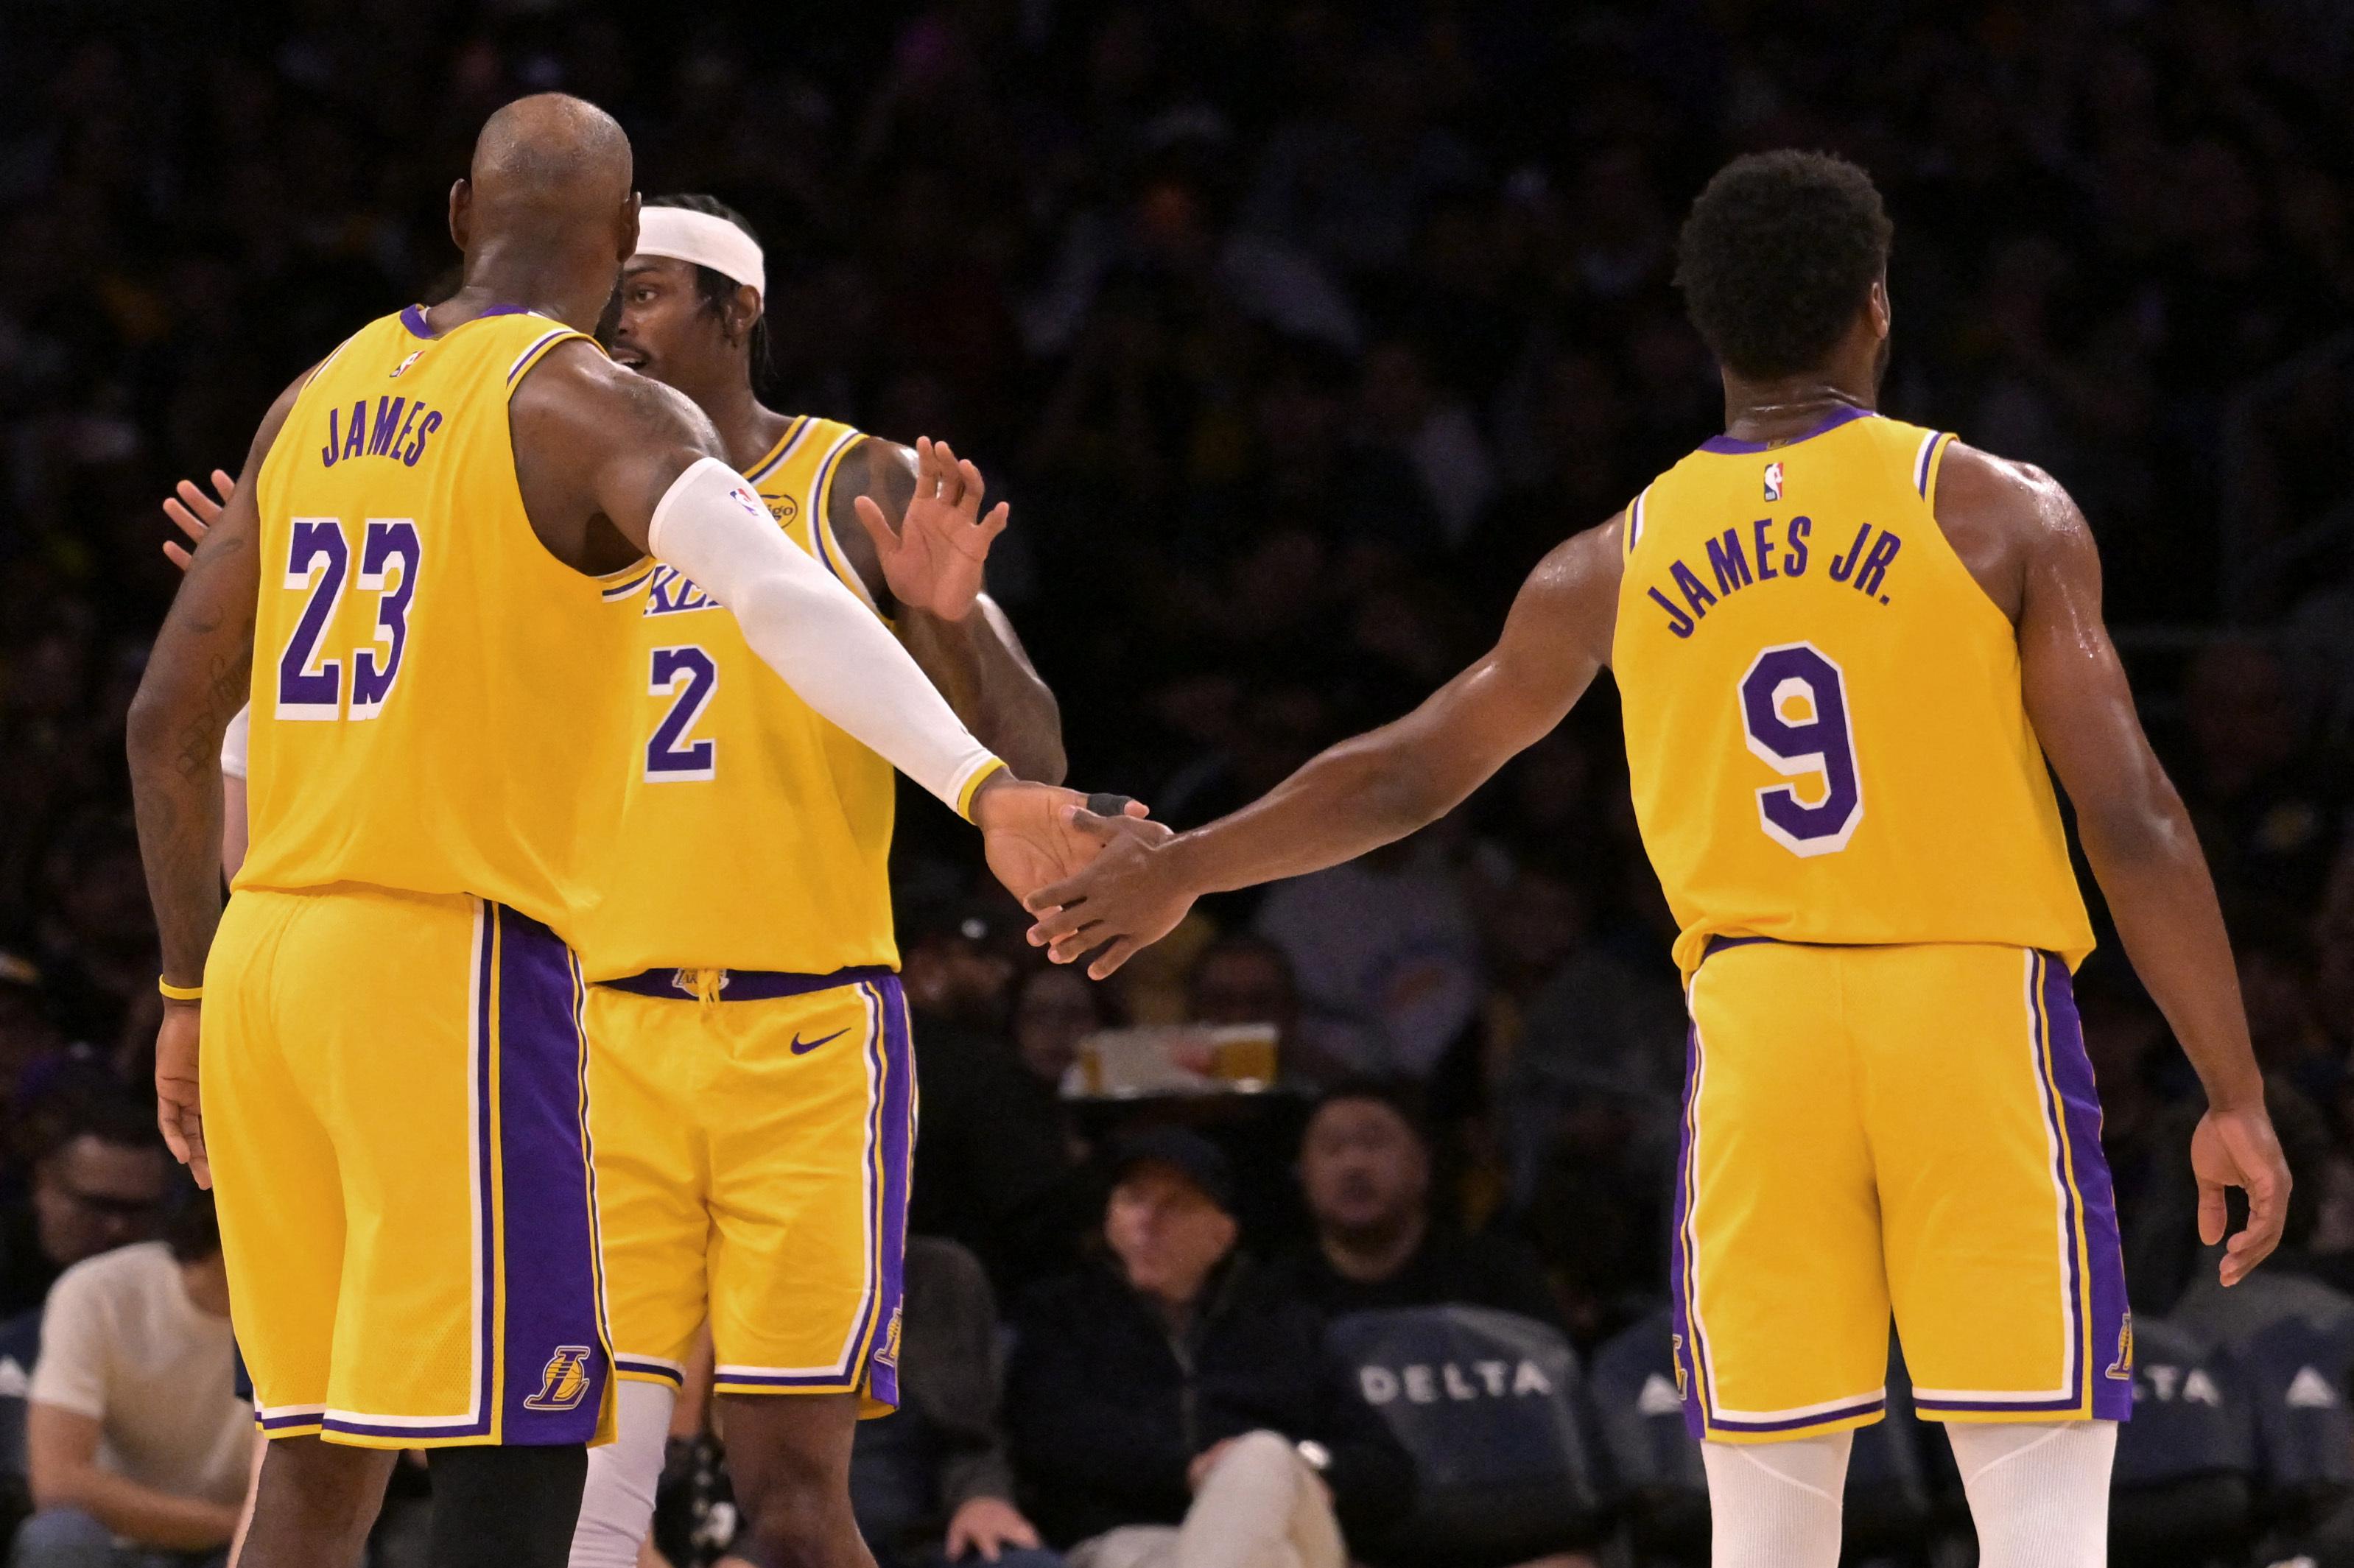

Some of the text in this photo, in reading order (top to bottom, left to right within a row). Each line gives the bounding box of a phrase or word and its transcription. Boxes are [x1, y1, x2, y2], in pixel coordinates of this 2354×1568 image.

[322, 395, 443, 468] JAMES
[275, 517, 423, 721] 23
[1647, 516, 1902, 639] JAMES JR.
[643, 644, 718, 784] 2
[1737, 640, 1865, 859] 9
[1359, 1360, 1552, 1405] DELTA
